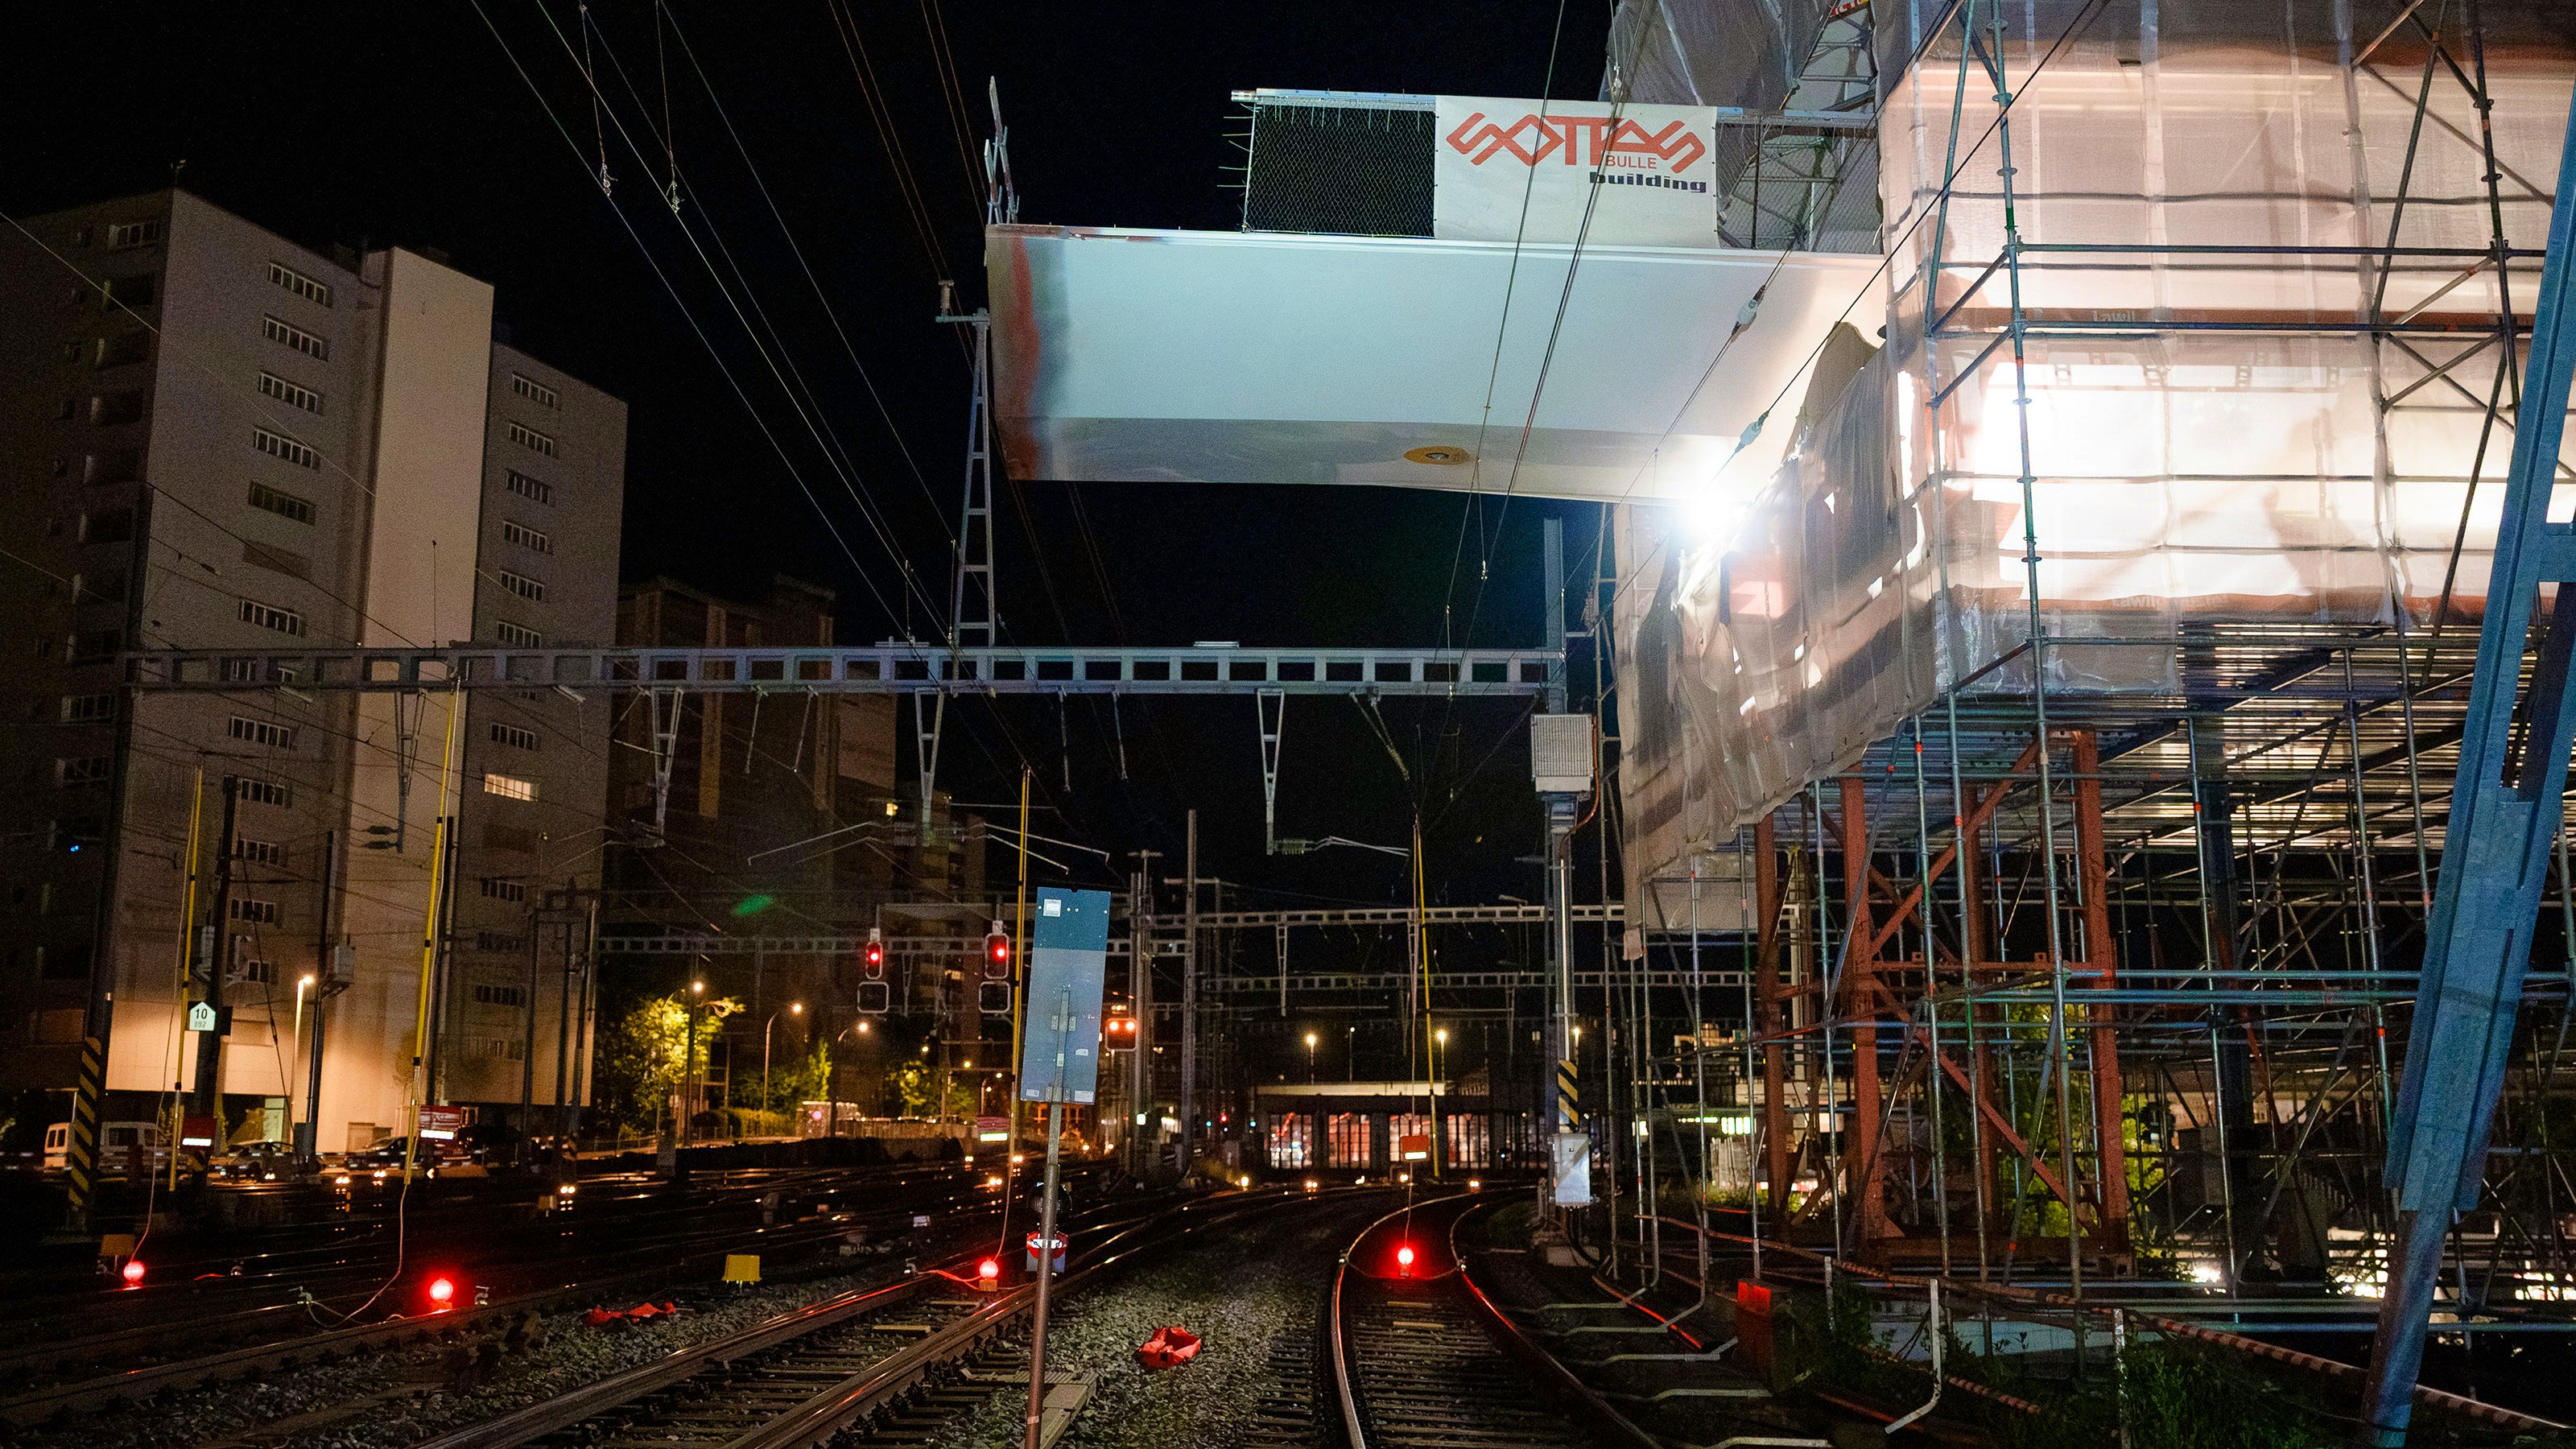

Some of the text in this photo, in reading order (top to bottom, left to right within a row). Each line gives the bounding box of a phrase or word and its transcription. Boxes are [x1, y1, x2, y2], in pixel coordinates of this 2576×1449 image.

[1446, 112, 1707, 174] SOTTAS
[1605, 155, 1657, 169] BULLE
[1589, 171, 1707, 193] building
[196, 1008, 208, 1019] 10
